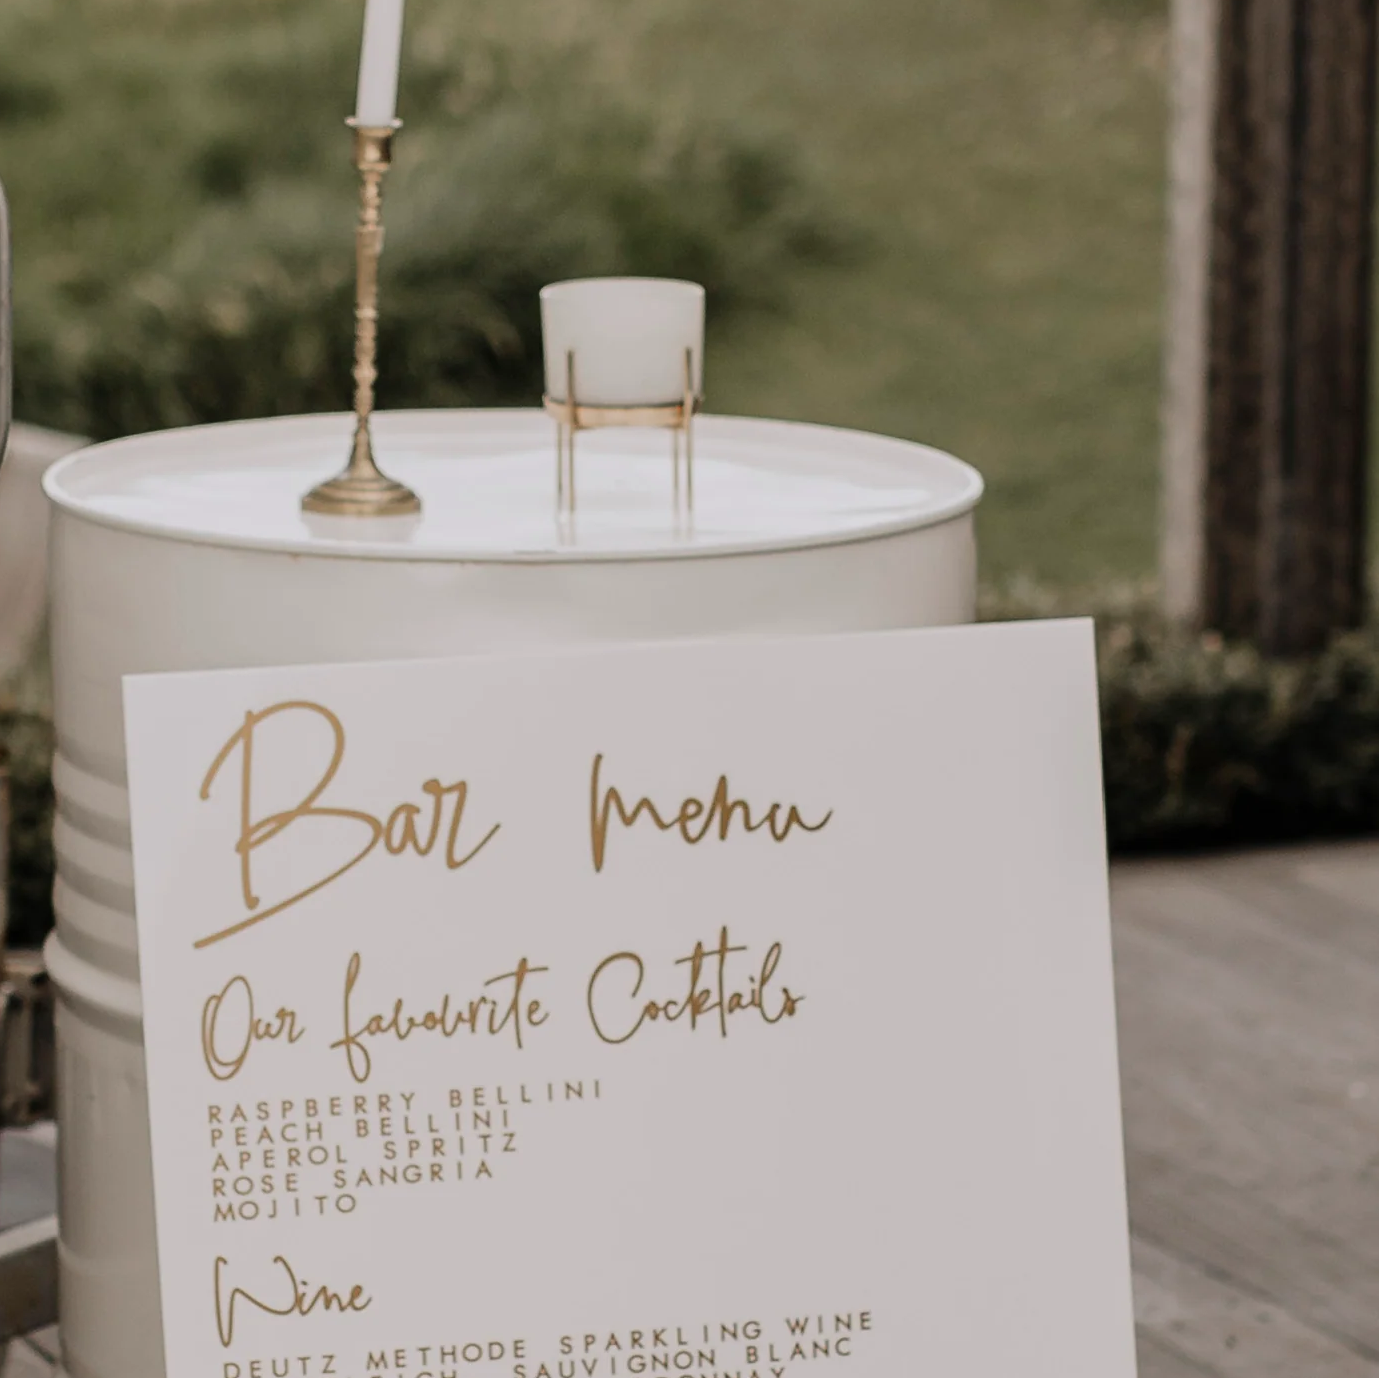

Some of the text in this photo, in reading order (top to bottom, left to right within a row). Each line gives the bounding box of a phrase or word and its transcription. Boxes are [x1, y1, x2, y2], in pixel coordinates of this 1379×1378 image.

[192, 700, 502, 950] Bar
[200, 924, 807, 1084] Our favourite Cocktails
[207, 1079, 600, 1125] RASPBERRY BELLINI
[210, 1108, 508, 1148] PEACH BELLINI
[211, 1132, 517, 1173] APEROL SPRITZ
[212, 1159, 493, 1198] ROSE SANGRIA
[213, 1193, 357, 1223] MOJITO
[213, 1254, 373, 1349] Wine
[365, 1338, 526, 1372] METHODE
[559, 1320, 763, 1356] SPARKLING
[784, 1310, 872, 1337] WINE
[745, 1336, 852, 1365] BLANC
